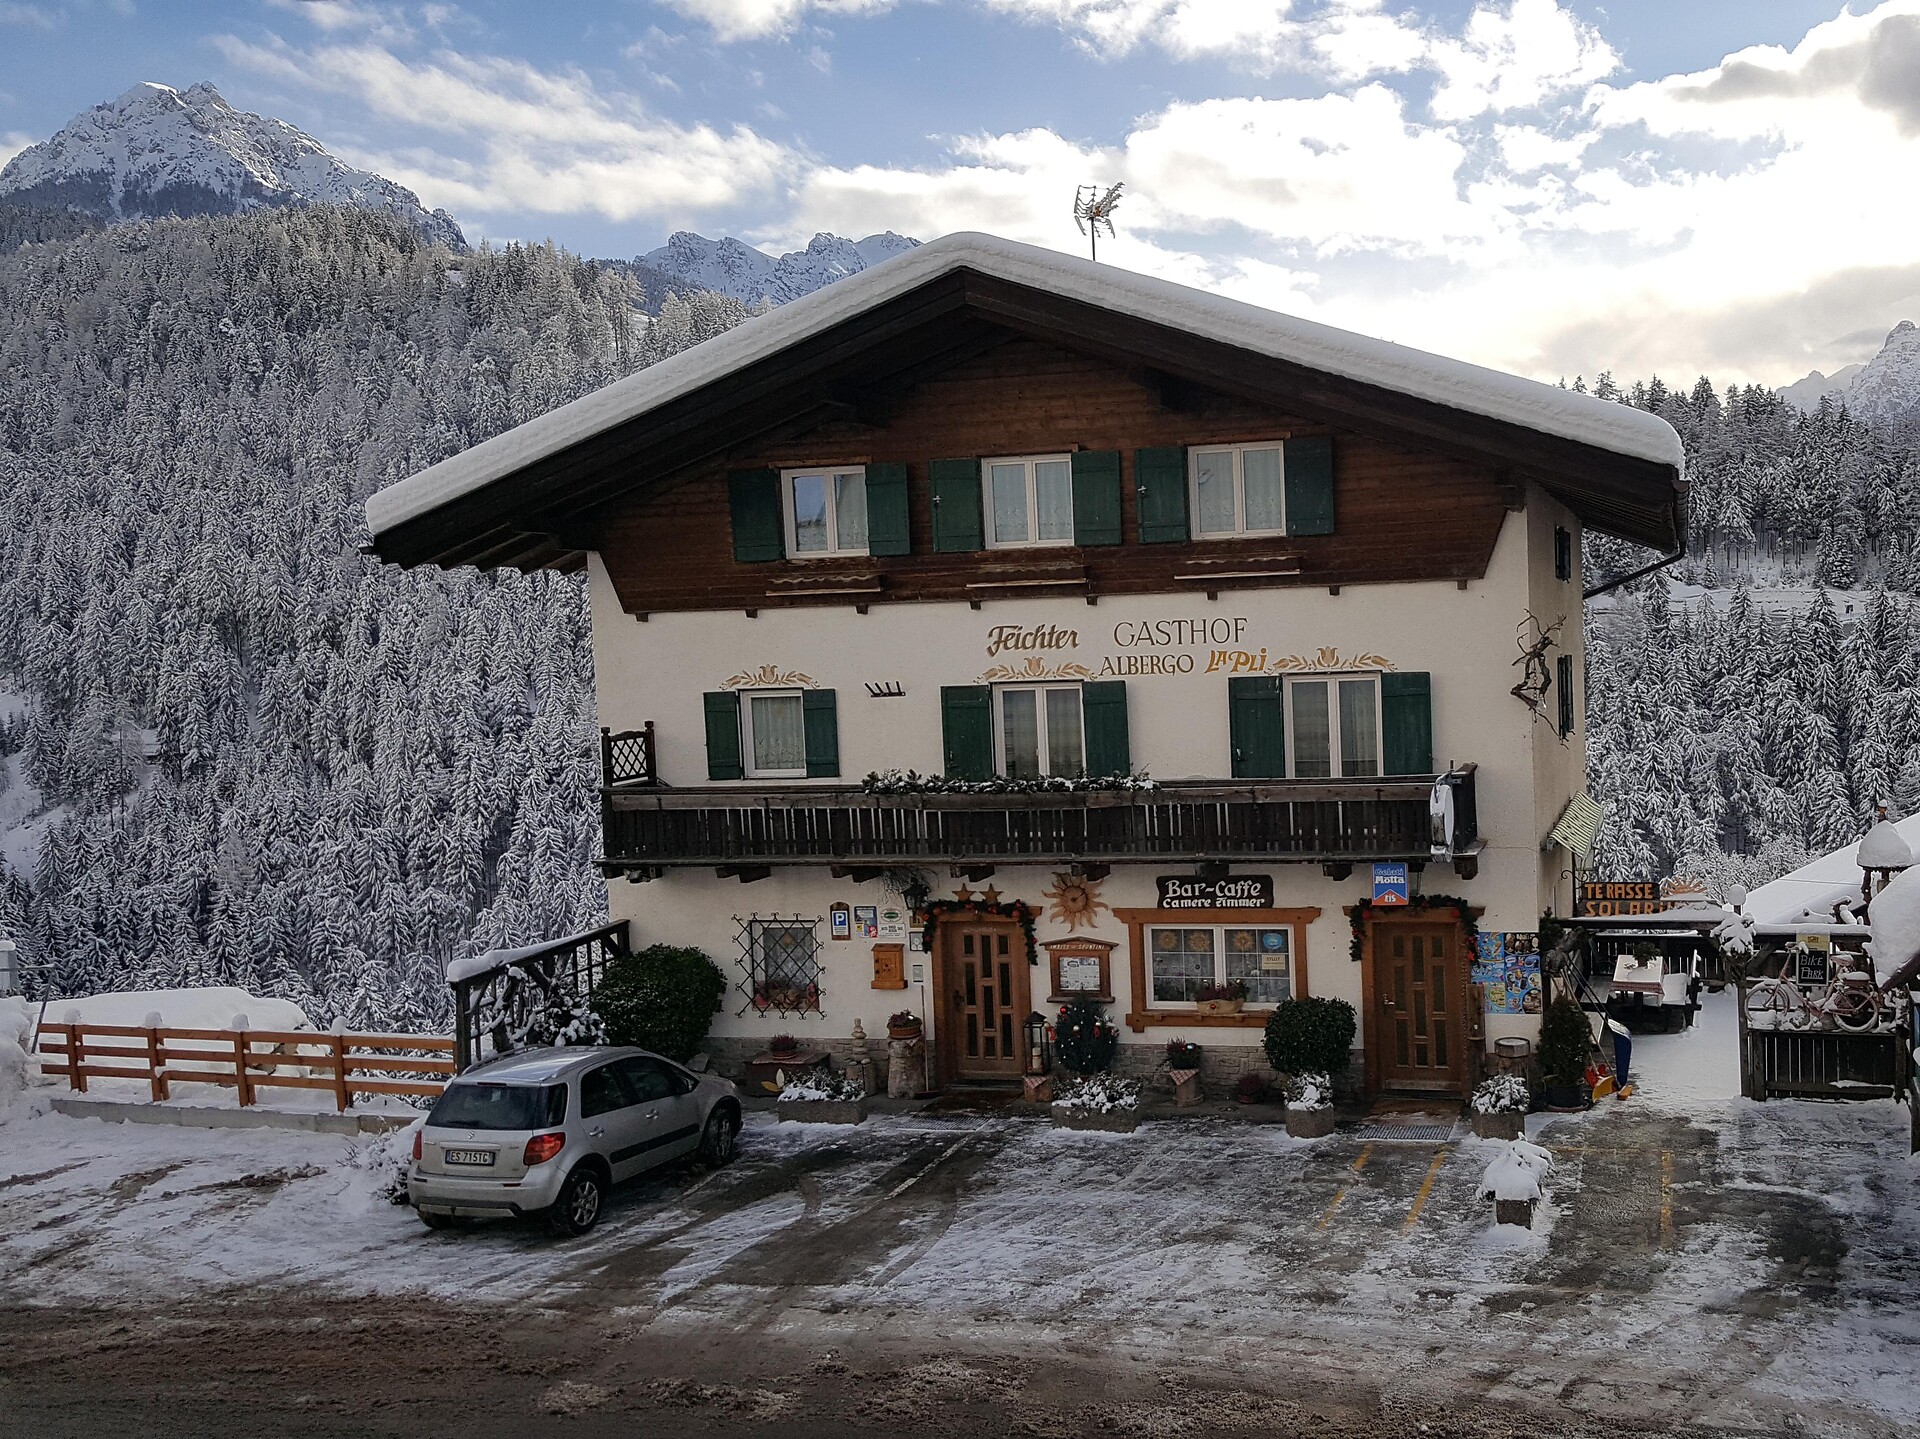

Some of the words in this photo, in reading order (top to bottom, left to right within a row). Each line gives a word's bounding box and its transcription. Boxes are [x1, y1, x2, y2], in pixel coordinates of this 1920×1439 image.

[987, 623, 1079, 658] Feichter
[1113, 617, 1248, 647] GASTHOF
[1098, 654, 1194, 677] ALBERGO
[1165, 880, 1261, 898] Bar-Caffe
[1374, 876, 1405, 884] Motta
[835, 913, 845, 925] P
[1800, 955, 1823, 966] BIKE
